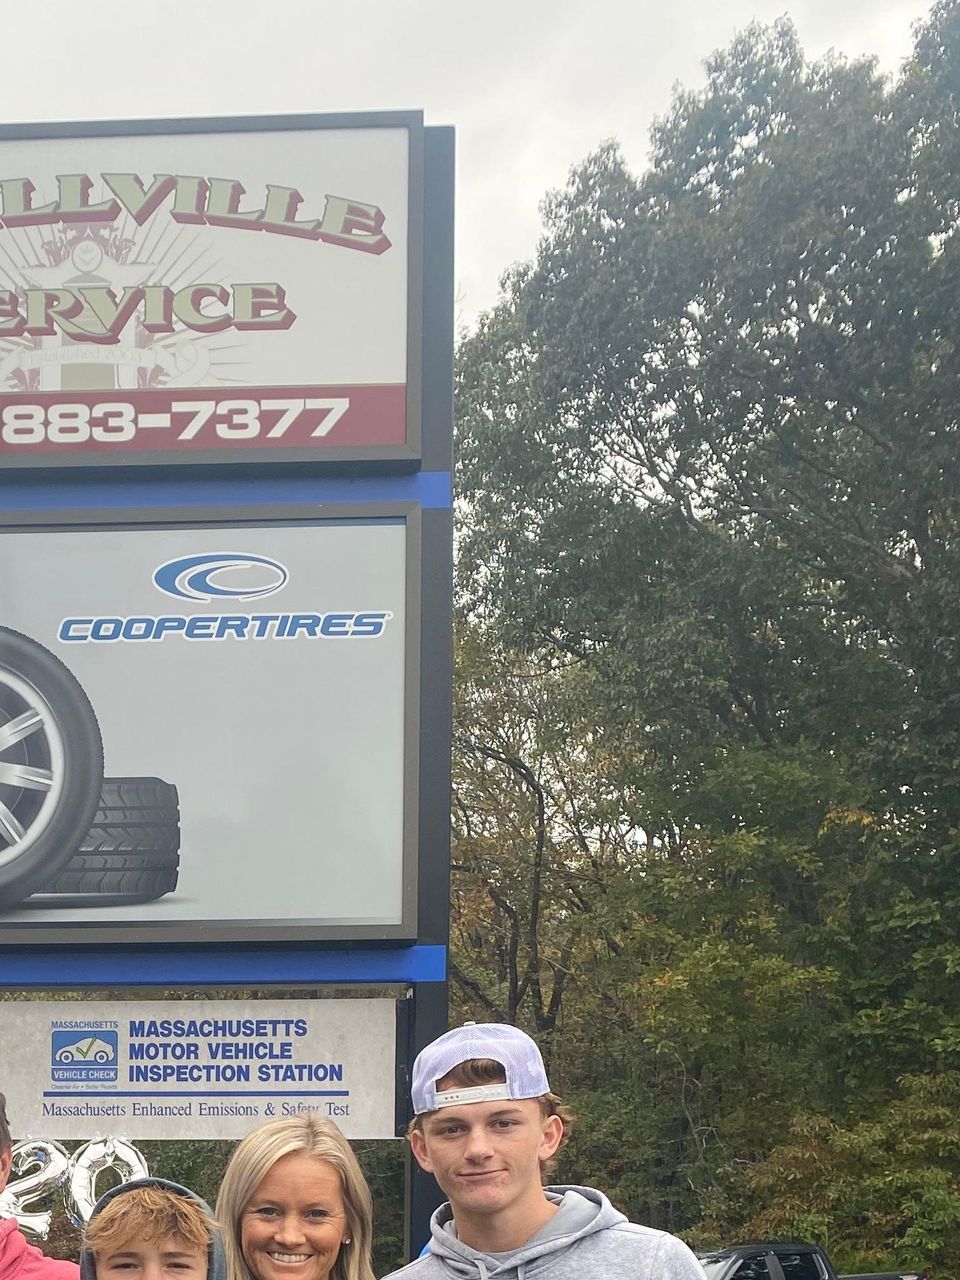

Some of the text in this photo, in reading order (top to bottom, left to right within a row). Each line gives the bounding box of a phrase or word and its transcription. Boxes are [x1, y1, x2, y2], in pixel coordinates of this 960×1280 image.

[51, 1021, 119, 1029] MASSACHUSETTS
[129, 1019, 308, 1037] MASSACHUSETTS
[129, 1042, 293, 1060] MOTOR VEHICLE
[53, 1070, 117, 1079] VEHICLE CHECK
[129, 1064, 343, 1082] INSPECTION STATION
[42, 1102, 126, 1116] Massachusetts
[132, 1102, 192, 1116] Enhanced
[199, 1102, 259, 1116] Emissions
[264, 1103, 275, 1116] &
[325, 1102, 350, 1116] Test
